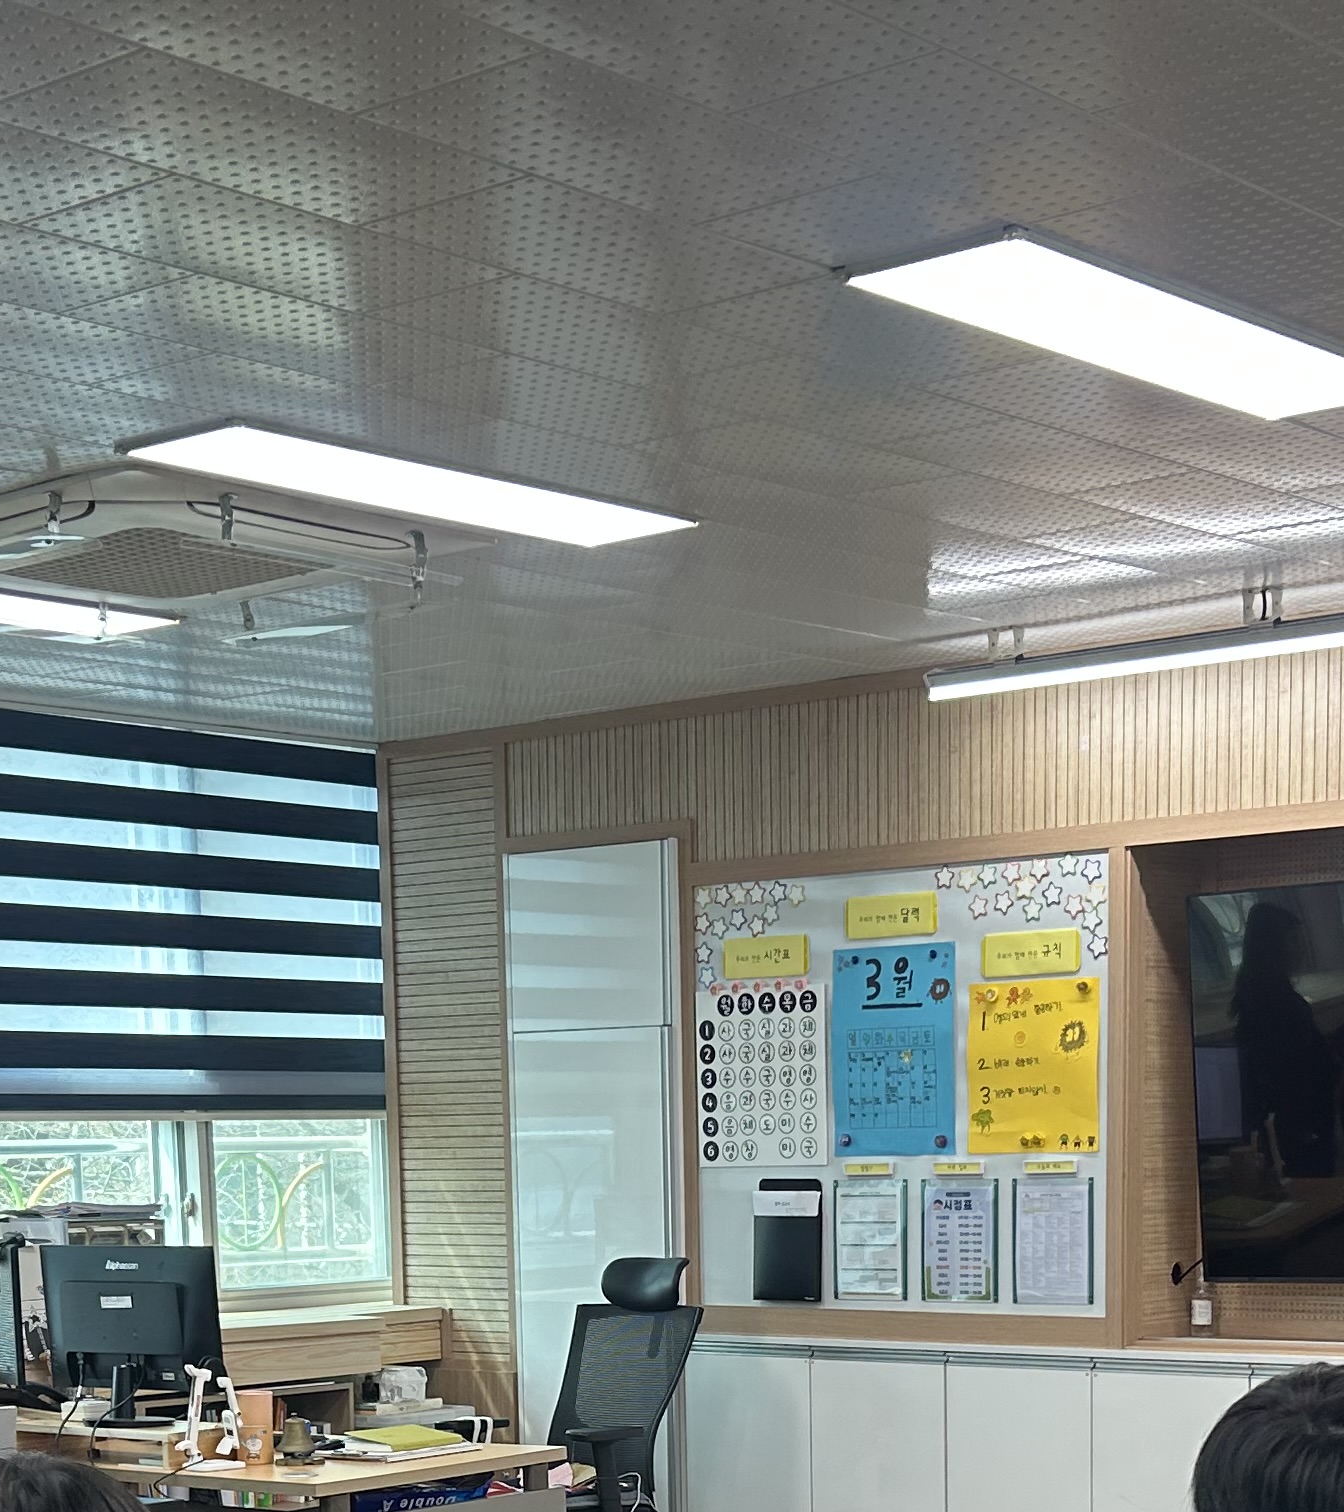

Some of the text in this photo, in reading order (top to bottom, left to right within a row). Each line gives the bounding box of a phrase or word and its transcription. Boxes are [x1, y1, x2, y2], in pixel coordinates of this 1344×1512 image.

[900, 907, 920, 923] 달력
[763, 948, 790, 964] 시간표
[1041, 942, 1062, 959] 규칙
